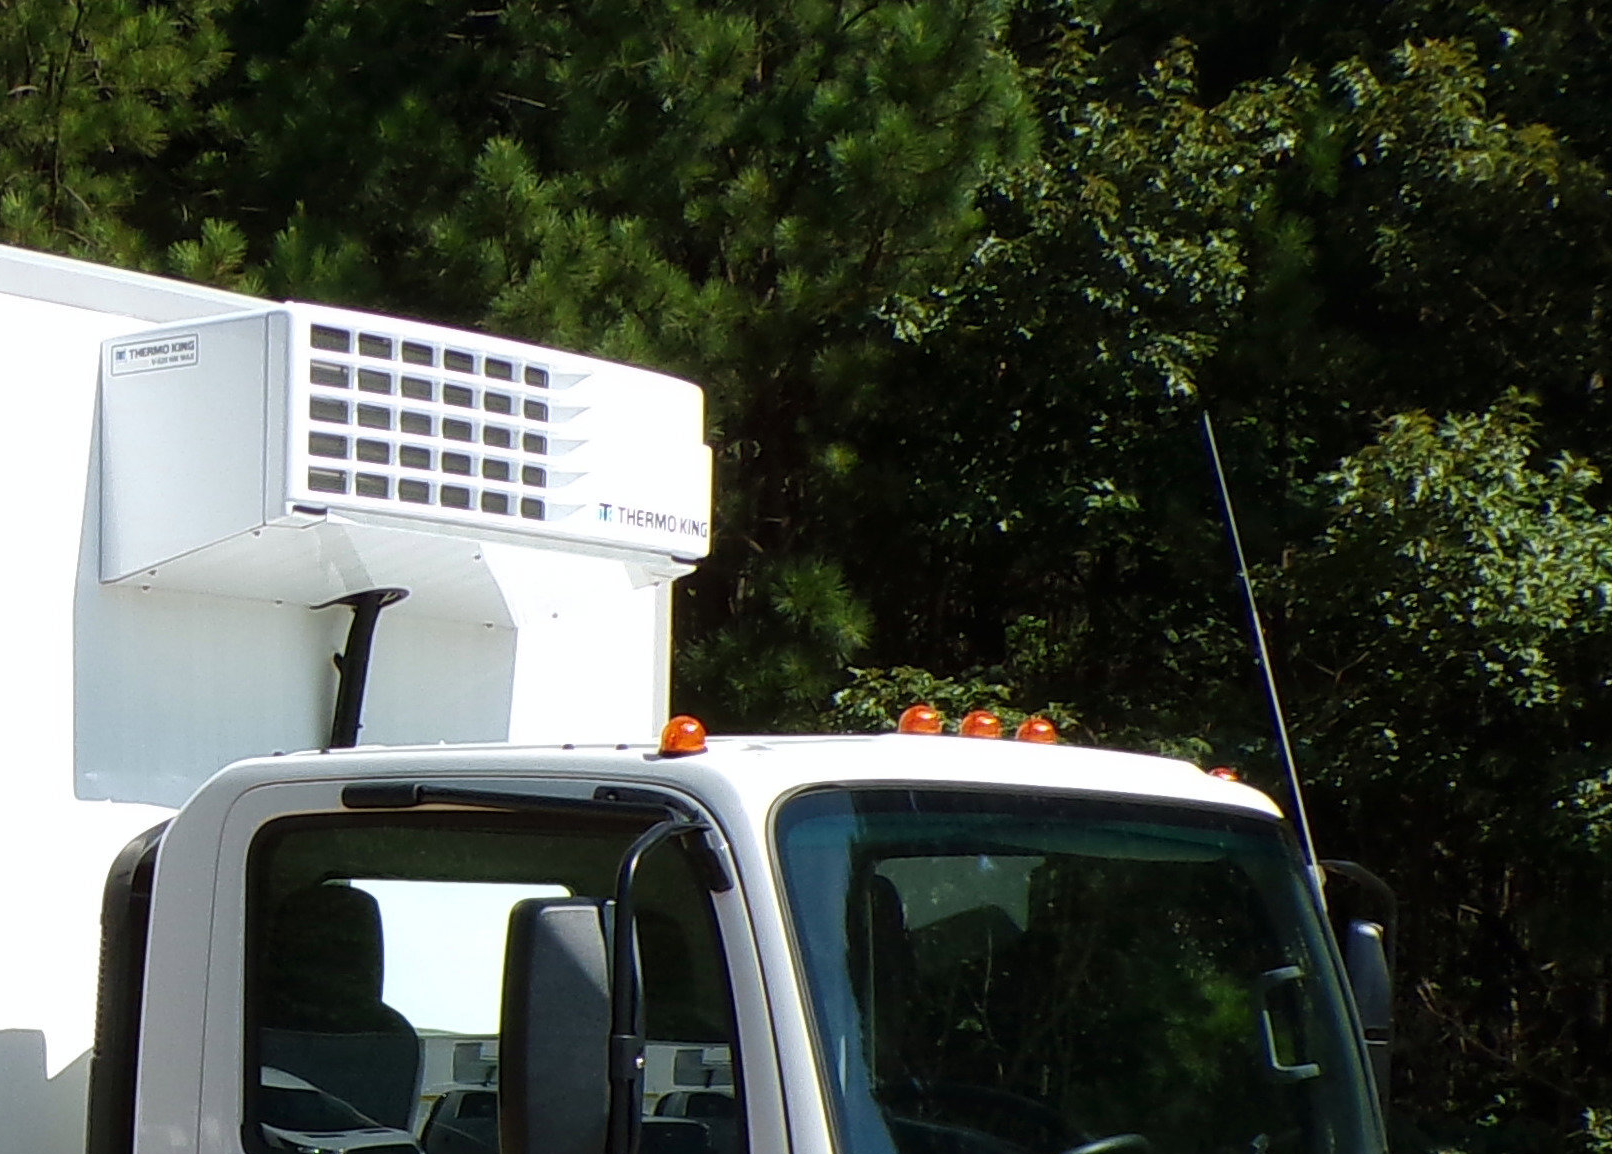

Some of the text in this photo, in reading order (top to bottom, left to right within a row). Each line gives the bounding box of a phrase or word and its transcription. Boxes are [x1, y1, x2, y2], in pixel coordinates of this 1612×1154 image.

[129, 340, 195, 359] THERMO KING
[618, 506, 677, 533] THERMO
[679, 517, 708, 538] KING
